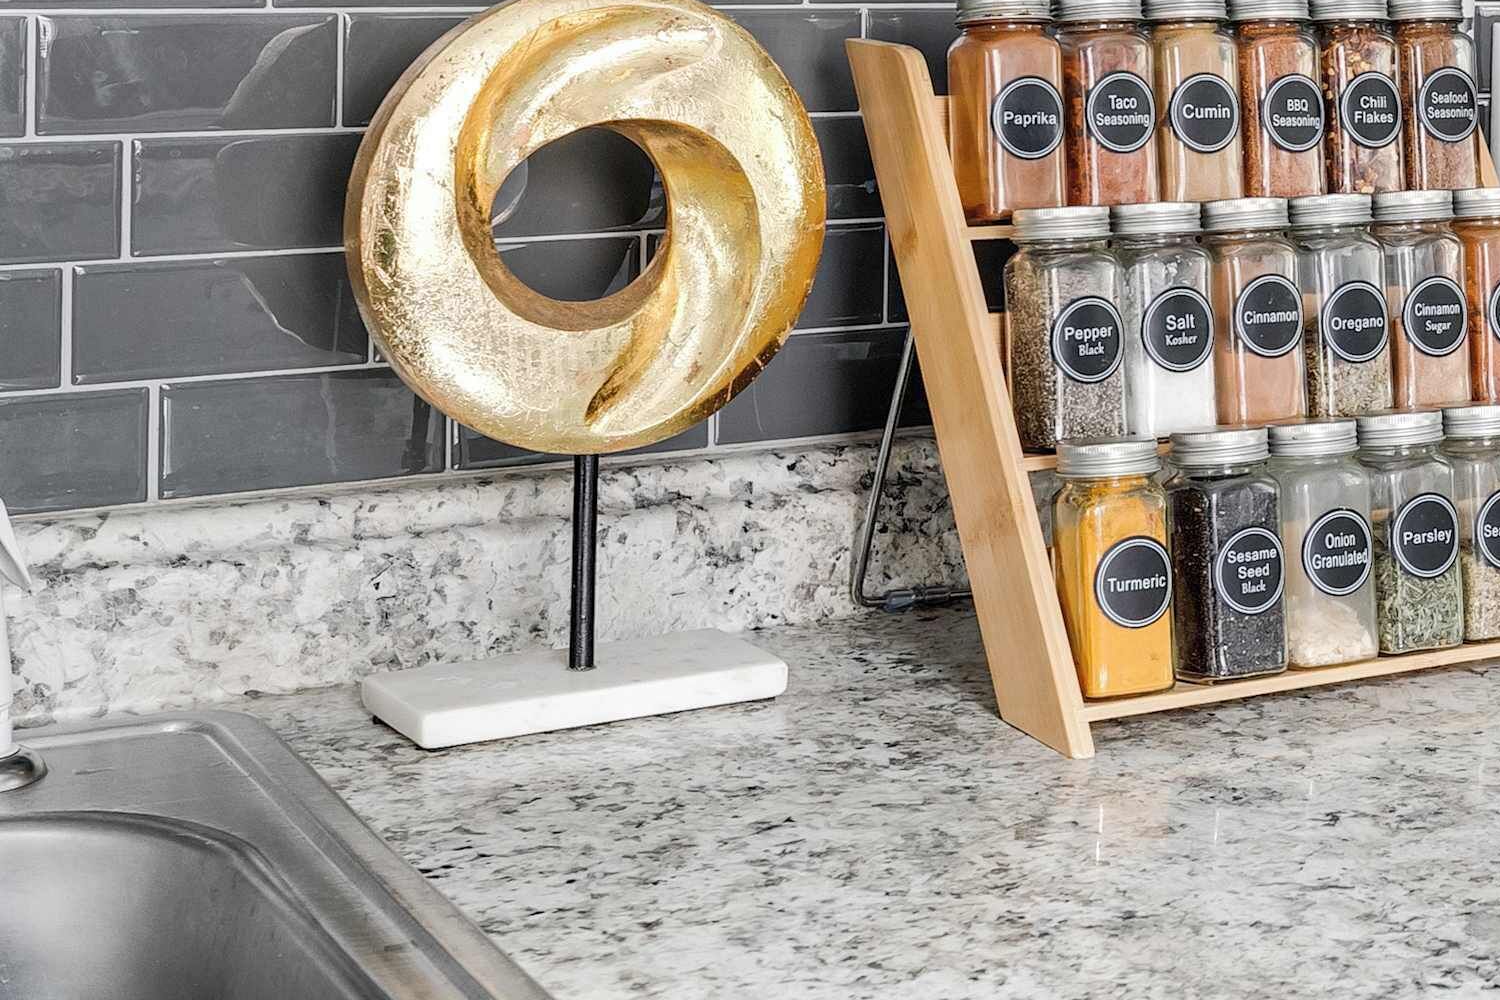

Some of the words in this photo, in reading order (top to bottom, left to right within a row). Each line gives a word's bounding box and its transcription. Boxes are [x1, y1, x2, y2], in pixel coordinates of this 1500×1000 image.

[1108, 94, 1137, 110] Taco
[1286, 98, 1309, 113] BBQ
[1359, 95, 1387, 109] Chili
[1430, 91, 1468, 105] Seafood
[1096, 111, 1150, 128] Seasoning
[1182, 103, 1231, 120] Cumin
[1354, 109, 1394, 125] Flakes
[1427, 105, 1474, 121] Seasoning
[1003, 111, 1057, 129] Paprika
[1272, 113, 1320, 130] Seasoning
[1243, 309, 1299, 325] Cinnamon
[1414, 302, 1461, 317] Cinnamon
[1165, 313, 1196, 331] Salt
[1331, 316, 1384, 332] Oregano
[1425, 319, 1452, 334] Sugar
[1064, 324, 1113, 343] Pepper
[1165, 332, 1198, 347] Kosher
[1078, 341, 1105, 357] Black
[1325, 532, 1356, 550] Onion
[1403, 528, 1453, 546] Parsley
[1227, 547, 1277, 564] Sesame
[1312, 549, 1368, 570] Granulated
[1237, 564, 1270, 580] Seed
[1107, 573, 1167, 593] Turmeric
[1241, 579, 1266, 595] Black
